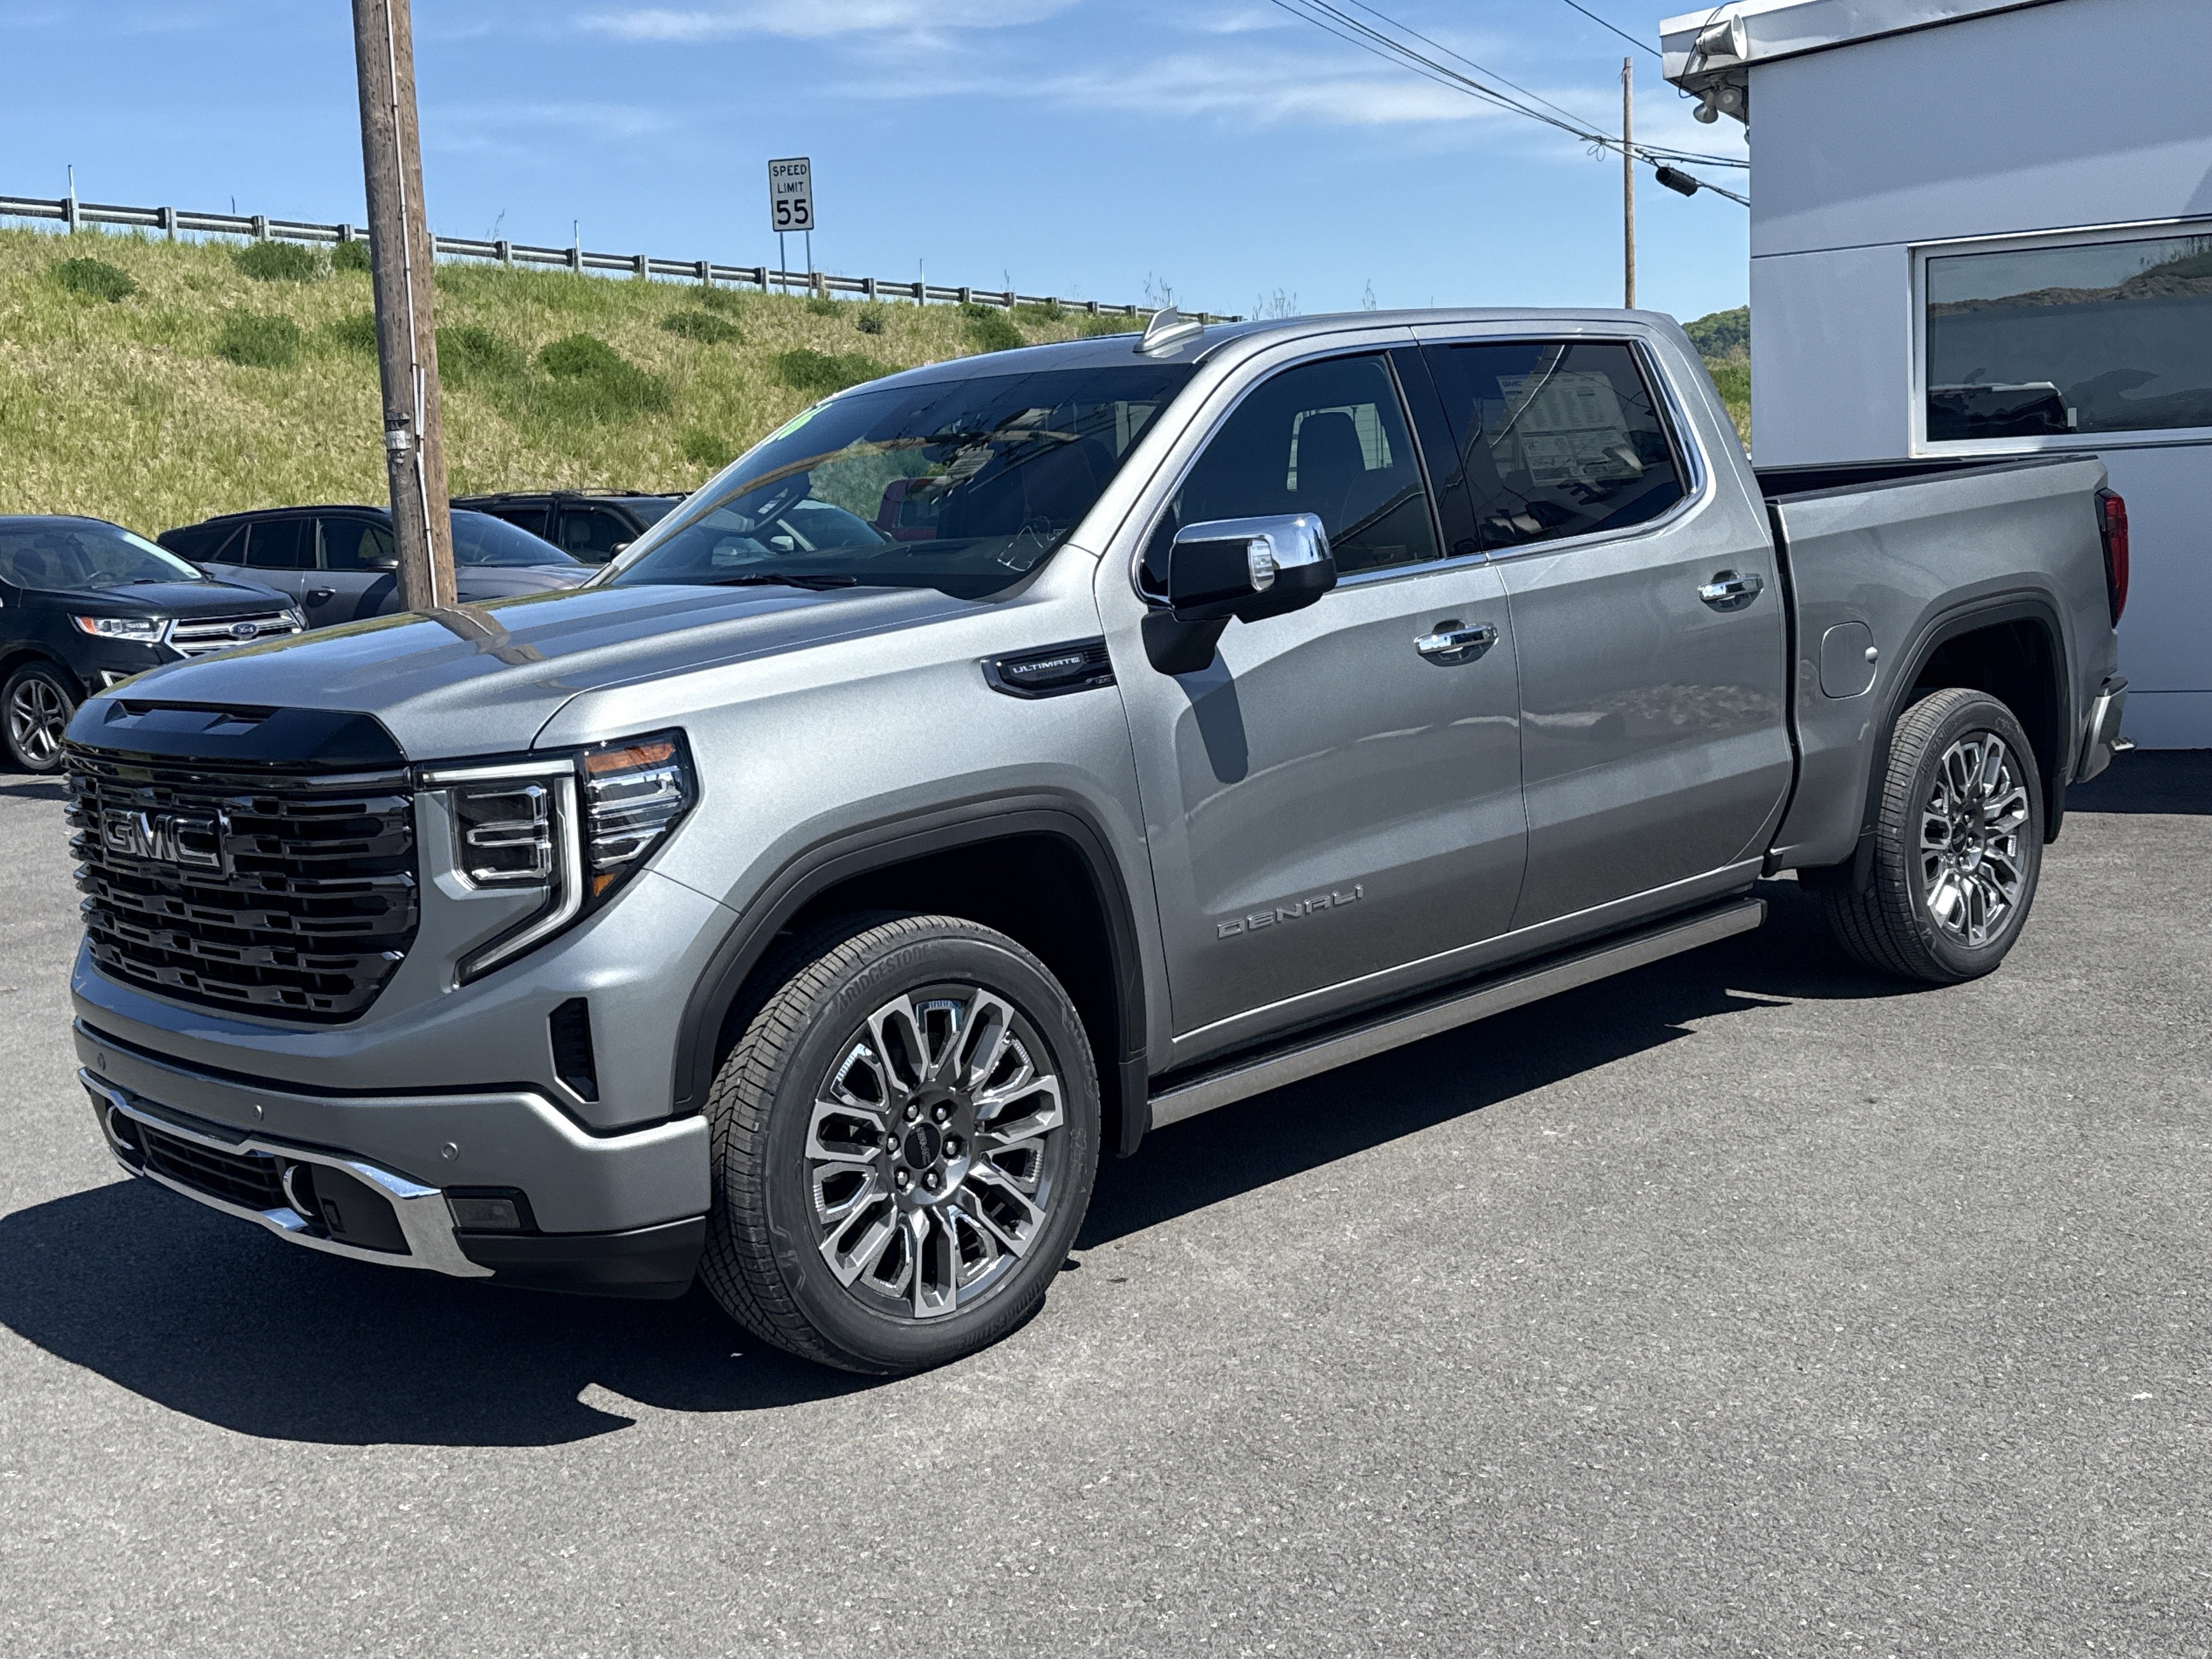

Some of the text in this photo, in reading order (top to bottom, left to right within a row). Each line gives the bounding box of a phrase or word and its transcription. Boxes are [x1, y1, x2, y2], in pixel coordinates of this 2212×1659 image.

[772, 165, 807, 177] SPEED
[777, 182, 804, 194] LIMIT
[776, 199, 809, 225] 55
[1013, 657, 1080, 674] ULTIMATE
[100, 808, 220, 867] GMC
[1217, 883, 1364, 940] DENALI
[916, 1127, 932, 1166] GMC
